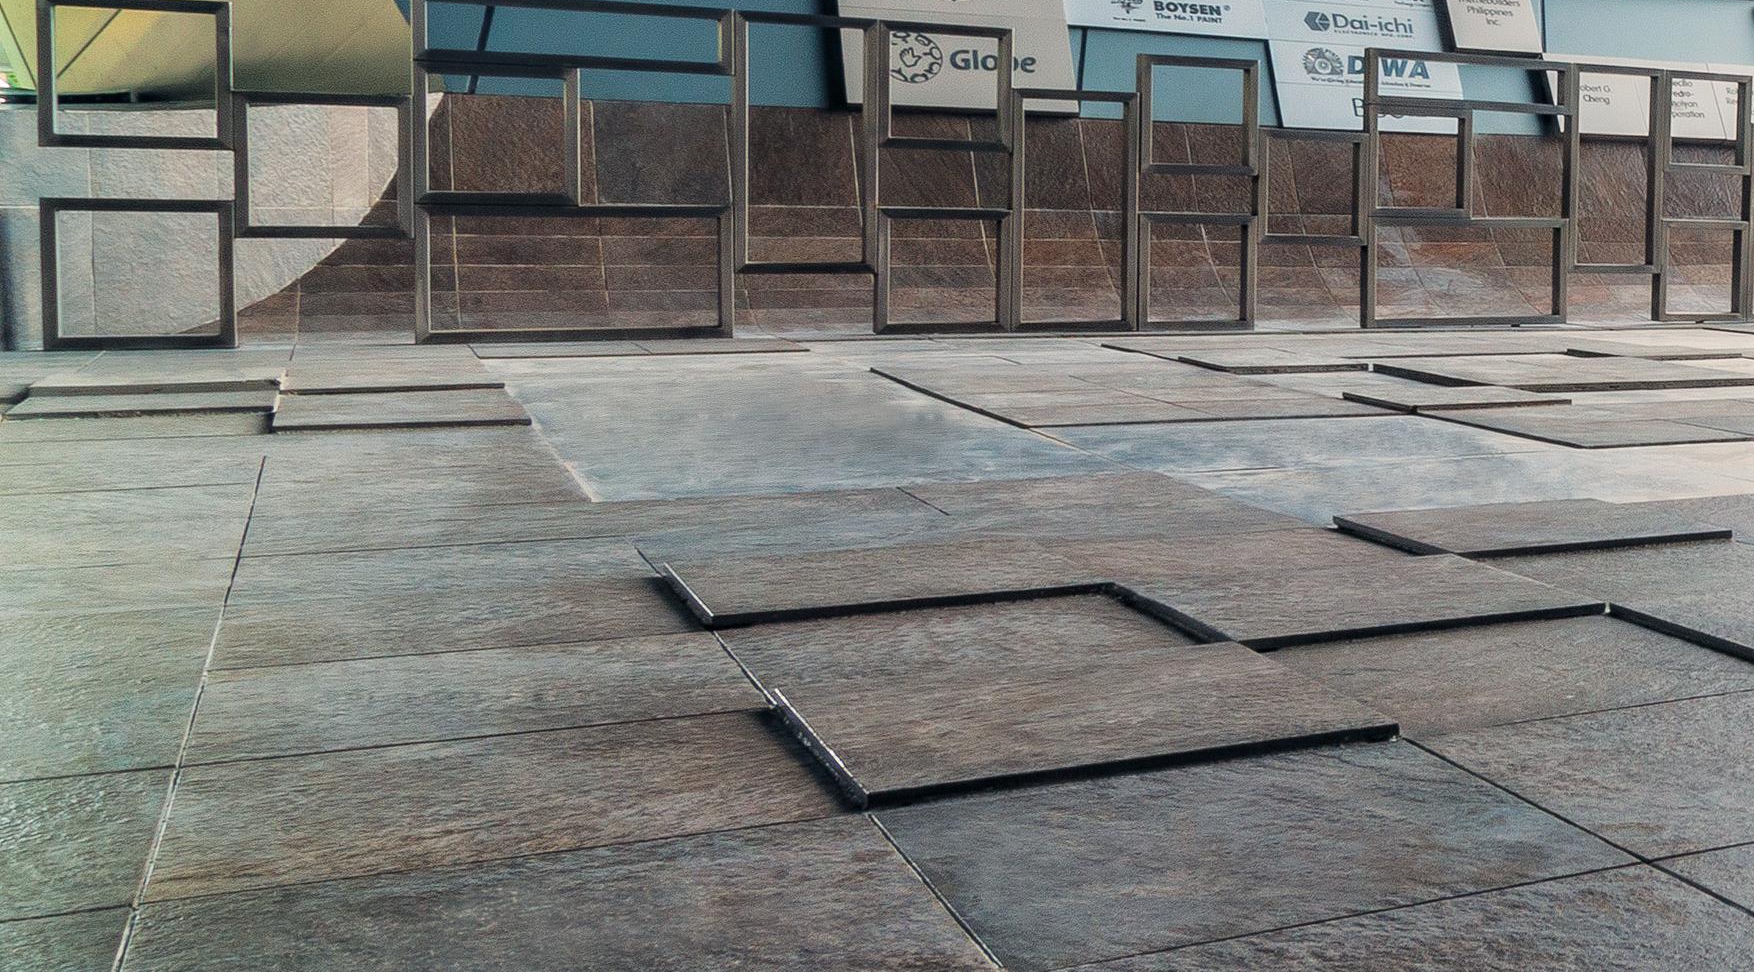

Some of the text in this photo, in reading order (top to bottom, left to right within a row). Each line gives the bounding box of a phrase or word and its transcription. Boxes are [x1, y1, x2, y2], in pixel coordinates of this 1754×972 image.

[1153, 0, 1222, 17] BOYSEN
[1466, 5, 1514, 17] Philippines
[1156, 12, 1172, 20] The
[1197, 15, 1223, 24] PAINT
[1331, 13, 1414, 34] Dai-ichi
[1347, 55, 1430, 79] DWA
[1579, 83, 1603, 94] obert
[1583, 94, 1611, 106] Cheng
[1673, 91, 1695, 99] edro-
